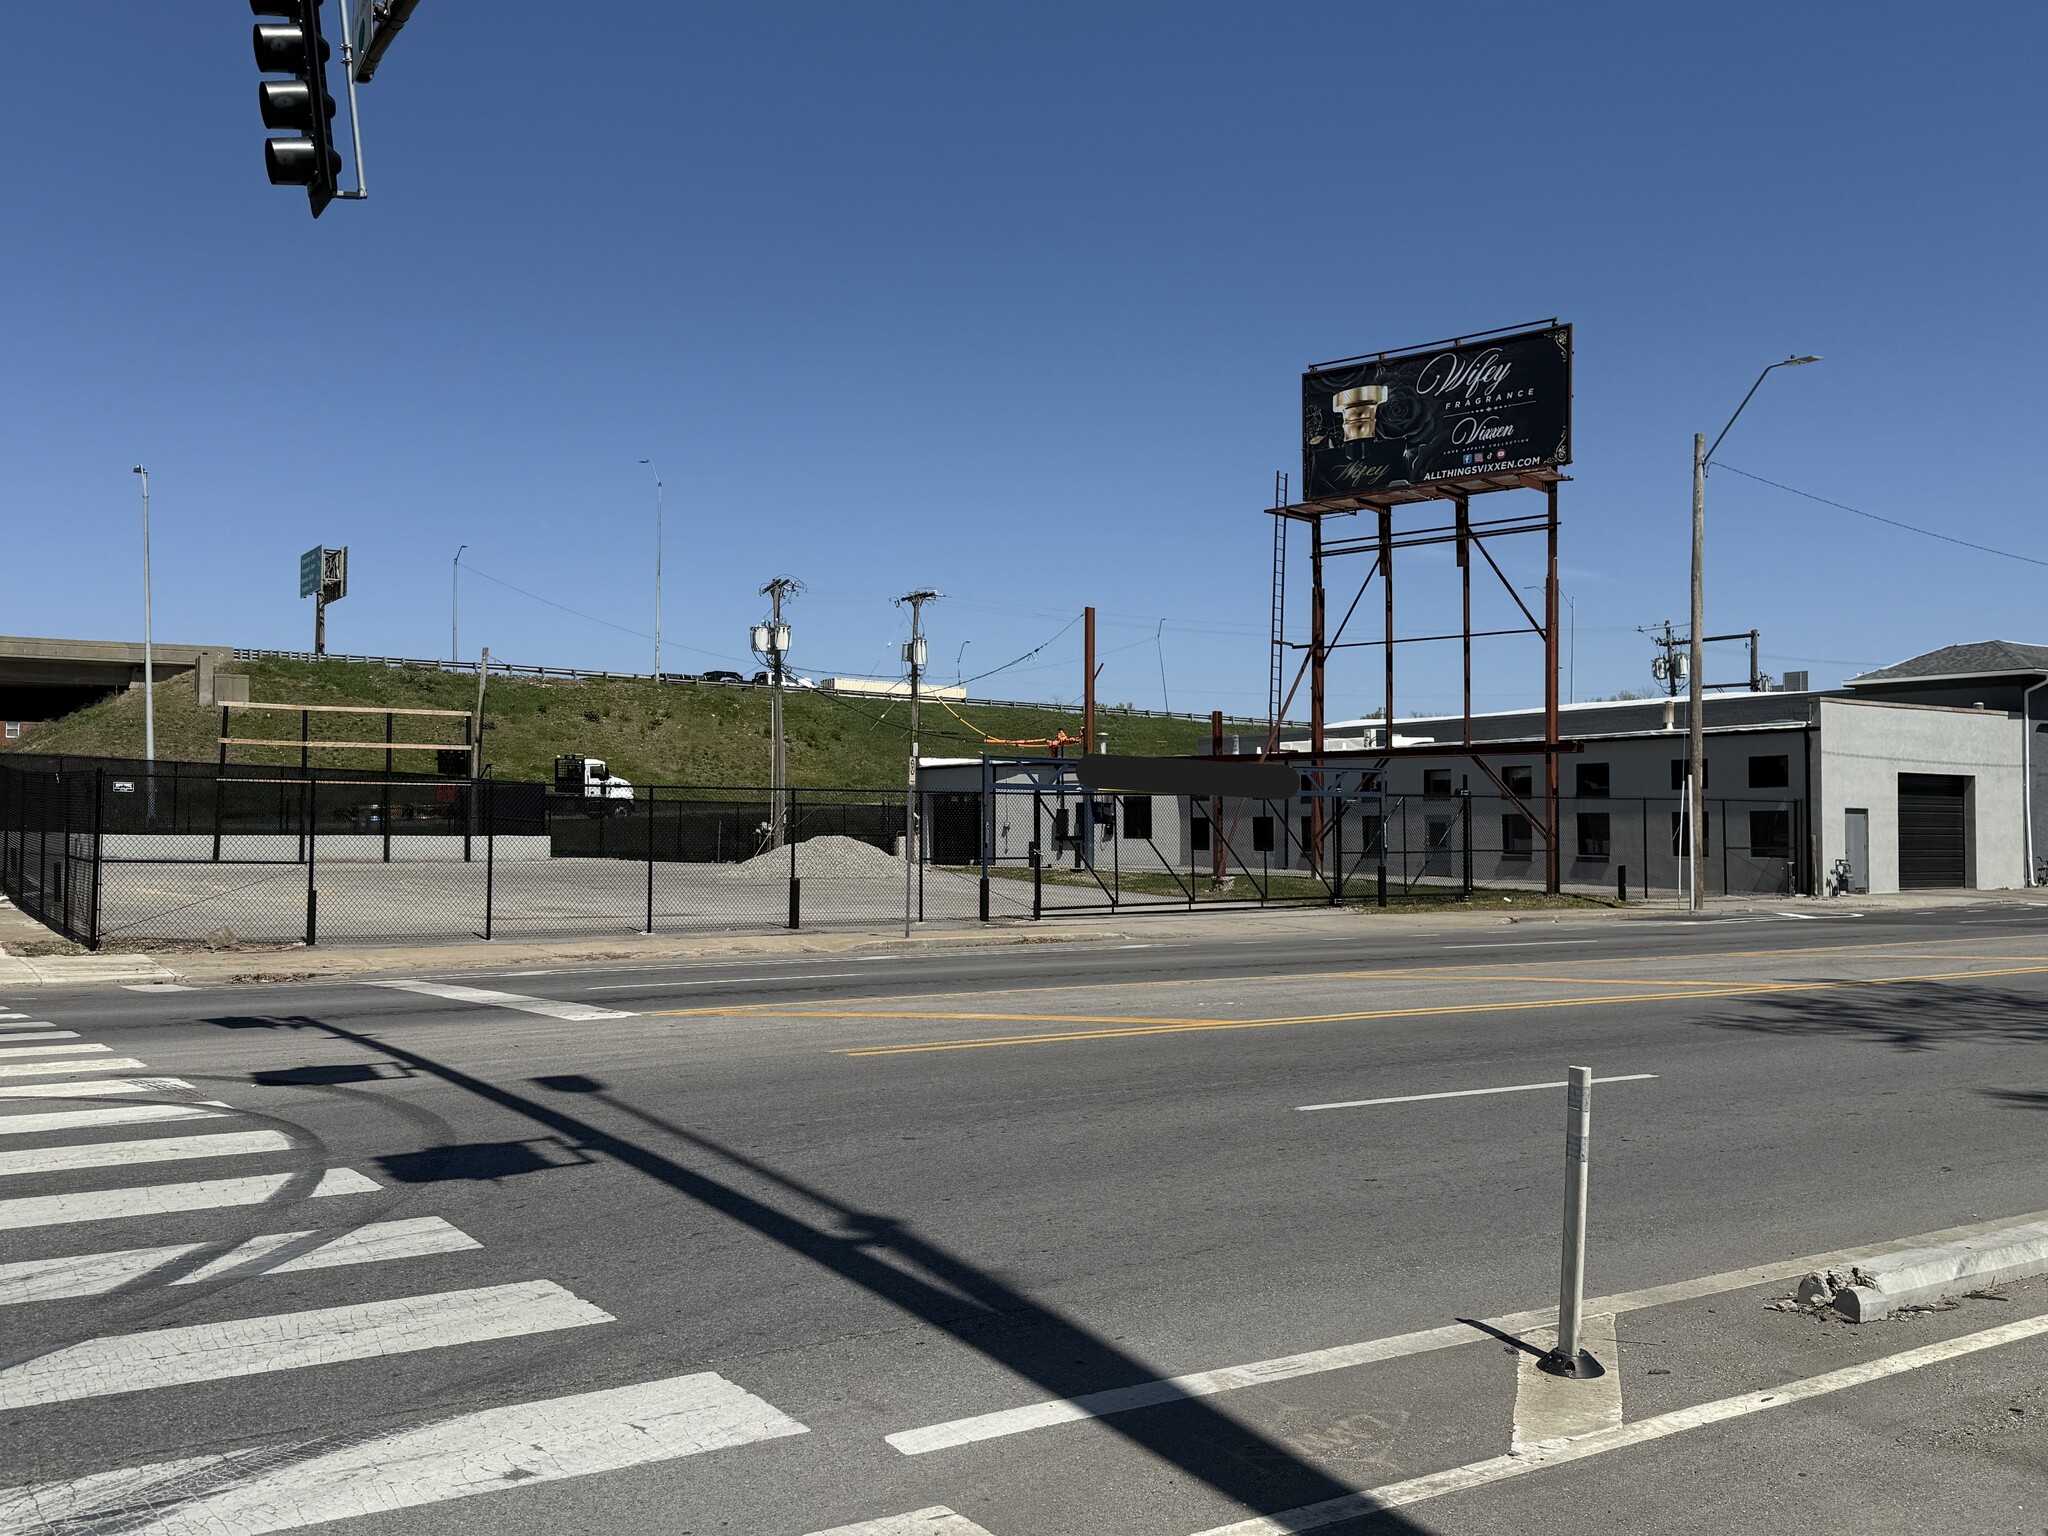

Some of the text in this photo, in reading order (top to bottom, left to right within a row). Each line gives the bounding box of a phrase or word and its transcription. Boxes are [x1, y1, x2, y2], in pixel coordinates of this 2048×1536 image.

[1416, 347, 1512, 398] Wifey
[1445, 388, 1535, 410] FRAGRANCE
[1451, 415, 1515, 445] Vixxen
[1330, 459, 1391, 487] Wifey
[1423, 456, 1541, 481] ALLTHINGSVIXXEN.COM
